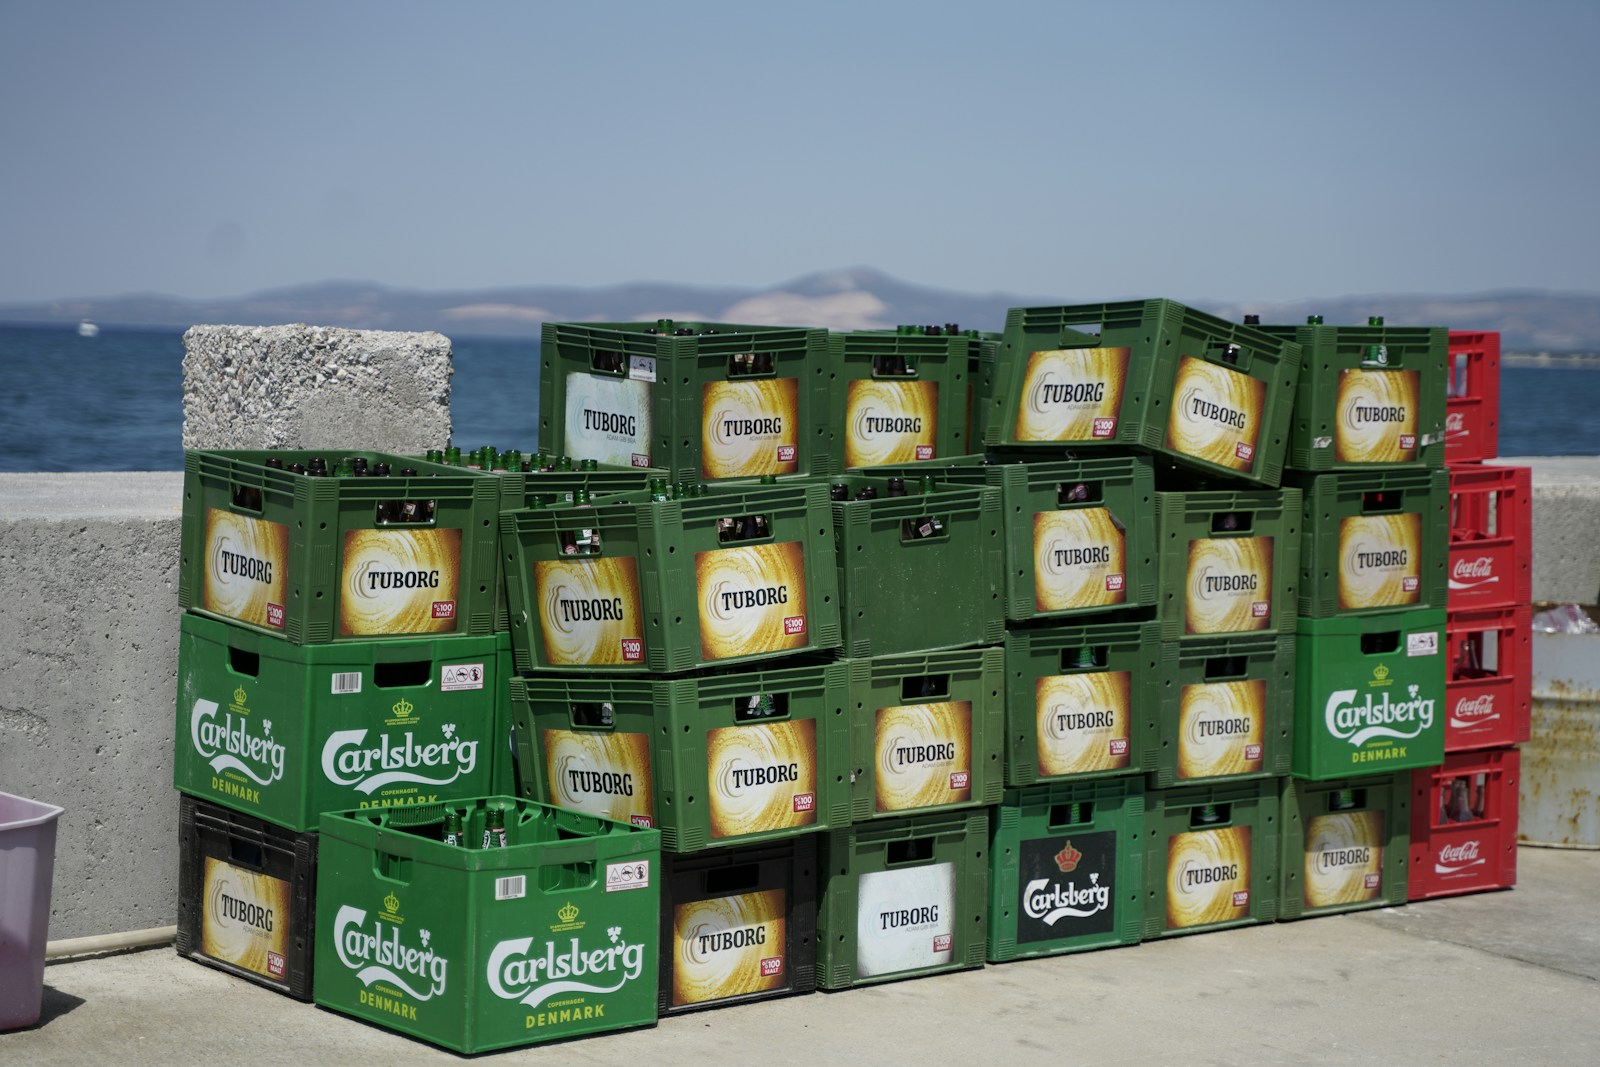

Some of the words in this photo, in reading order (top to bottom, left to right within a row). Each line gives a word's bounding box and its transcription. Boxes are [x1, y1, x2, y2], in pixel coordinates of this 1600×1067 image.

[1044, 382, 1104, 404] TUBORG
[584, 408, 636, 436] TUBORG
[1194, 398, 1244, 428] TUBORG
[1356, 406, 1404, 422] TUBORG
[724, 418, 782, 436] TUBORG
[866, 418, 920, 434] TUBORG
[222, 550, 272, 584] TUBORG
[1054, 546, 1110, 566] TUBORG
[1358, 550, 1406, 568] TUBORG
[368, 570, 438, 590] TUBORG
[1206, 574, 1257, 593] TUBORG
[722, 586, 788, 610] TUBORG
[560, 598, 624, 622] TUBORG
[1058, 710, 1114, 730] TUBORG
[1326, 689, 1435, 738] Carlsberg
[1200, 718, 1248, 736] TUBORG
[191, 698, 286, 781] Carlsberg
[322, 729, 478, 785] Carlsberg
[896, 742, 954, 764] TUBORG
[1352, 747, 1407, 763] DENMARK
[225, 771, 248, 783] COPENHAGEN
[568, 770, 634, 796] TUBORG
[732, 764, 798, 788] TUBORG
[212, 777, 259, 804] DENMARK
[381, 787, 418, 796] COPENHAGEN
[1322, 848, 1370, 867] TUBORG
[1186, 864, 1236, 886] TUBORG
[1023, 879, 1109, 919] Carlsberg
[222, 894, 272, 932] TUBORG
[880, 905, 938, 929] TUBORG
[334, 905, 447, 995] Carlsberg
[700, 926, 764, 954] TUBORG
[487, 937, 644, 999] Carlsberg
[376, 984, 402, 998] COPENHAGEN
[548, 998, 584, 1008] COPENHAGEN
[526, 1004, 604, 1028] DENMARK
